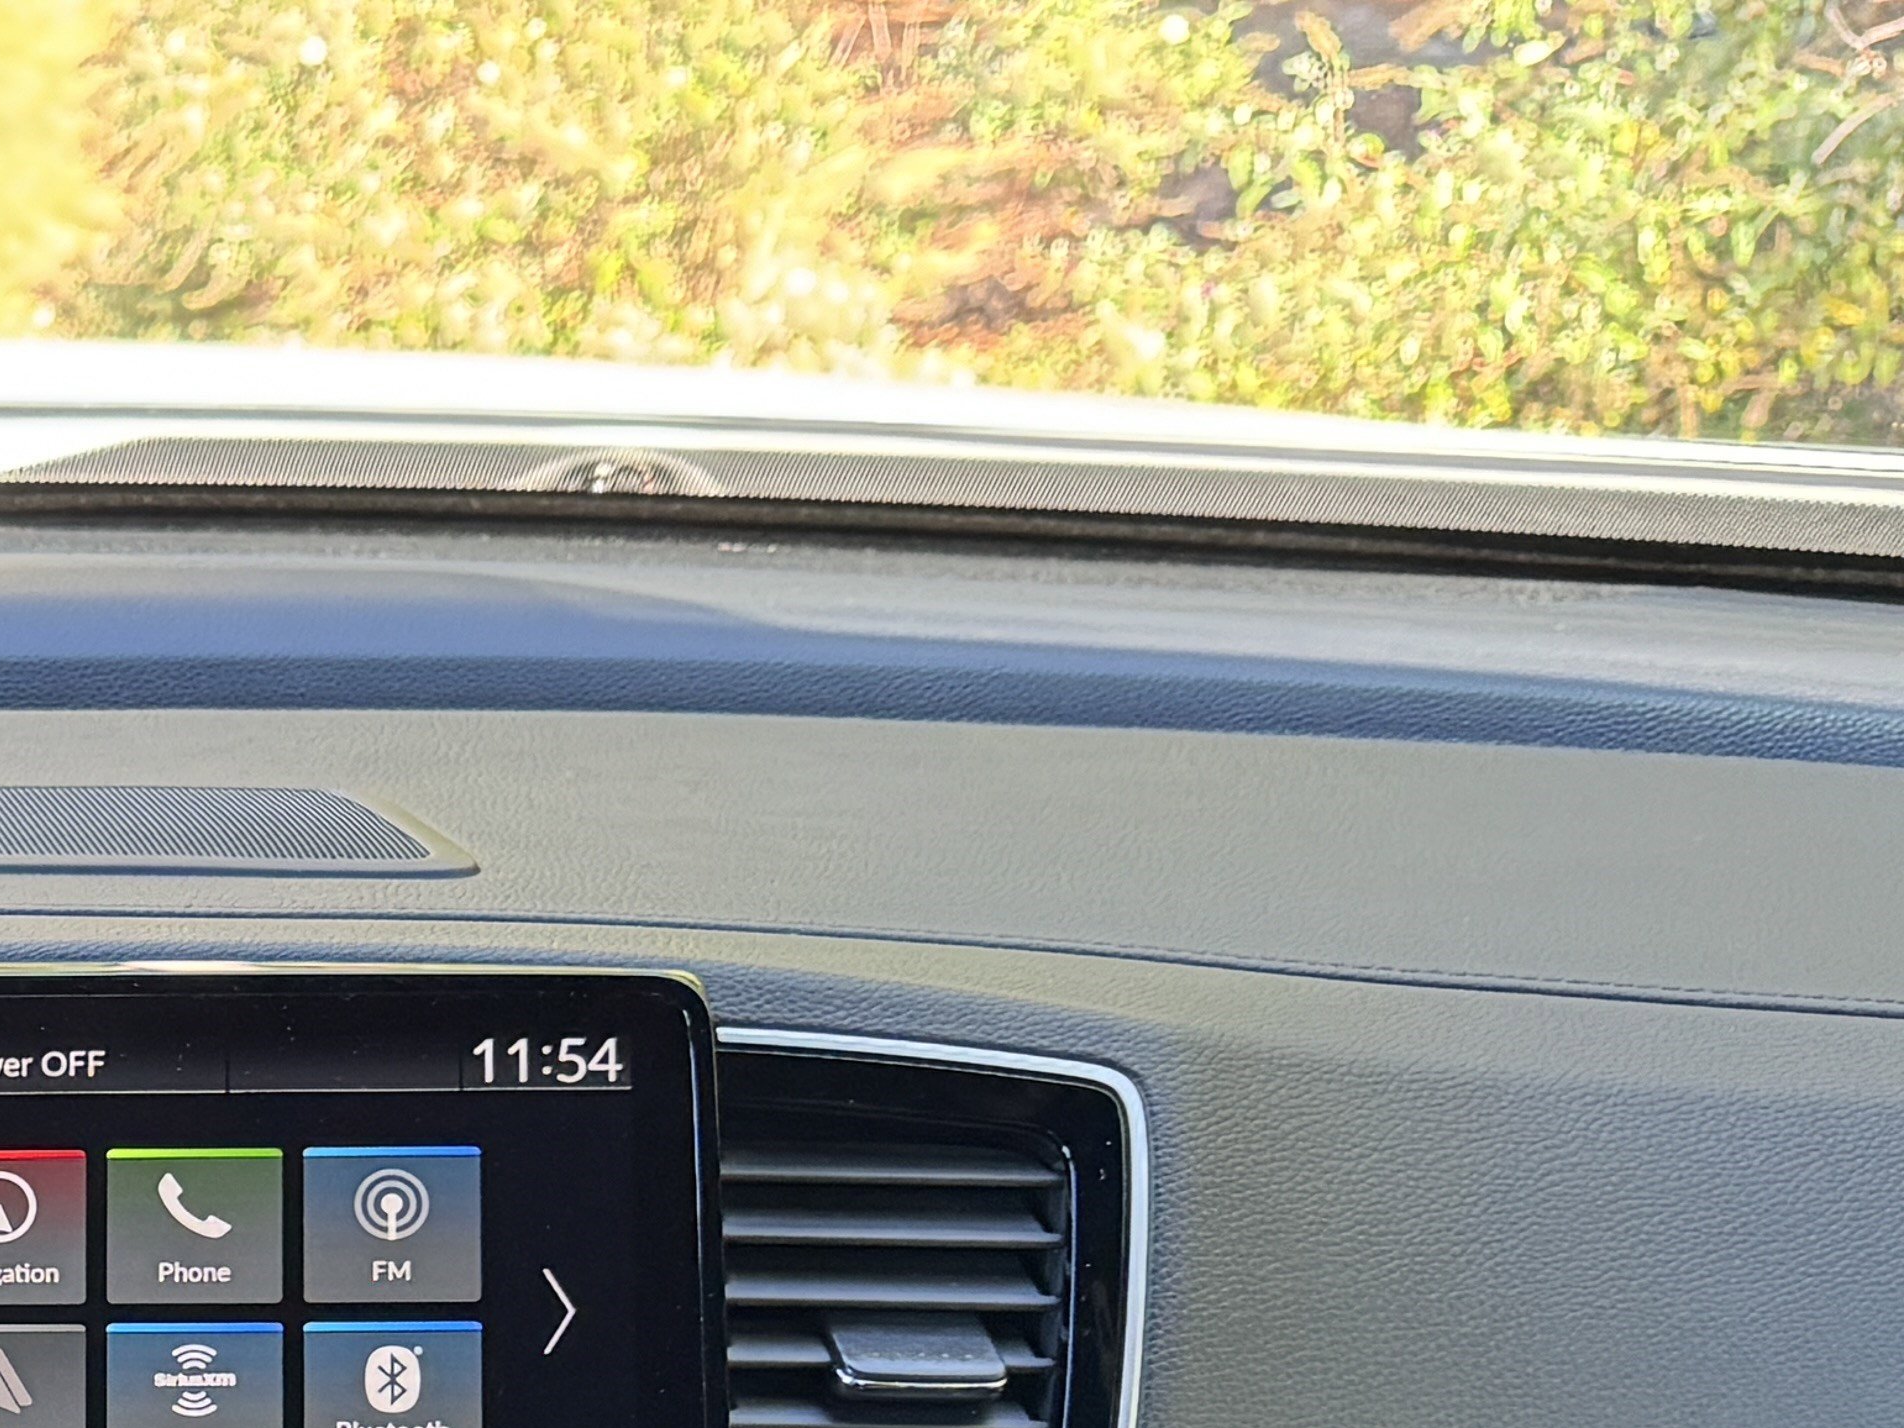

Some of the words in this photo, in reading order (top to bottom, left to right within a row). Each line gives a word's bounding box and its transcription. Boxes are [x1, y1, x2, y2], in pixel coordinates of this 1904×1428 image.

[41, 1051, 105, 1077] OFF
[473, 1038, 623, 1083] 11:54
[159, 1262, 231, 1282] Phone
[373, 1261, 411, 1281] FM
